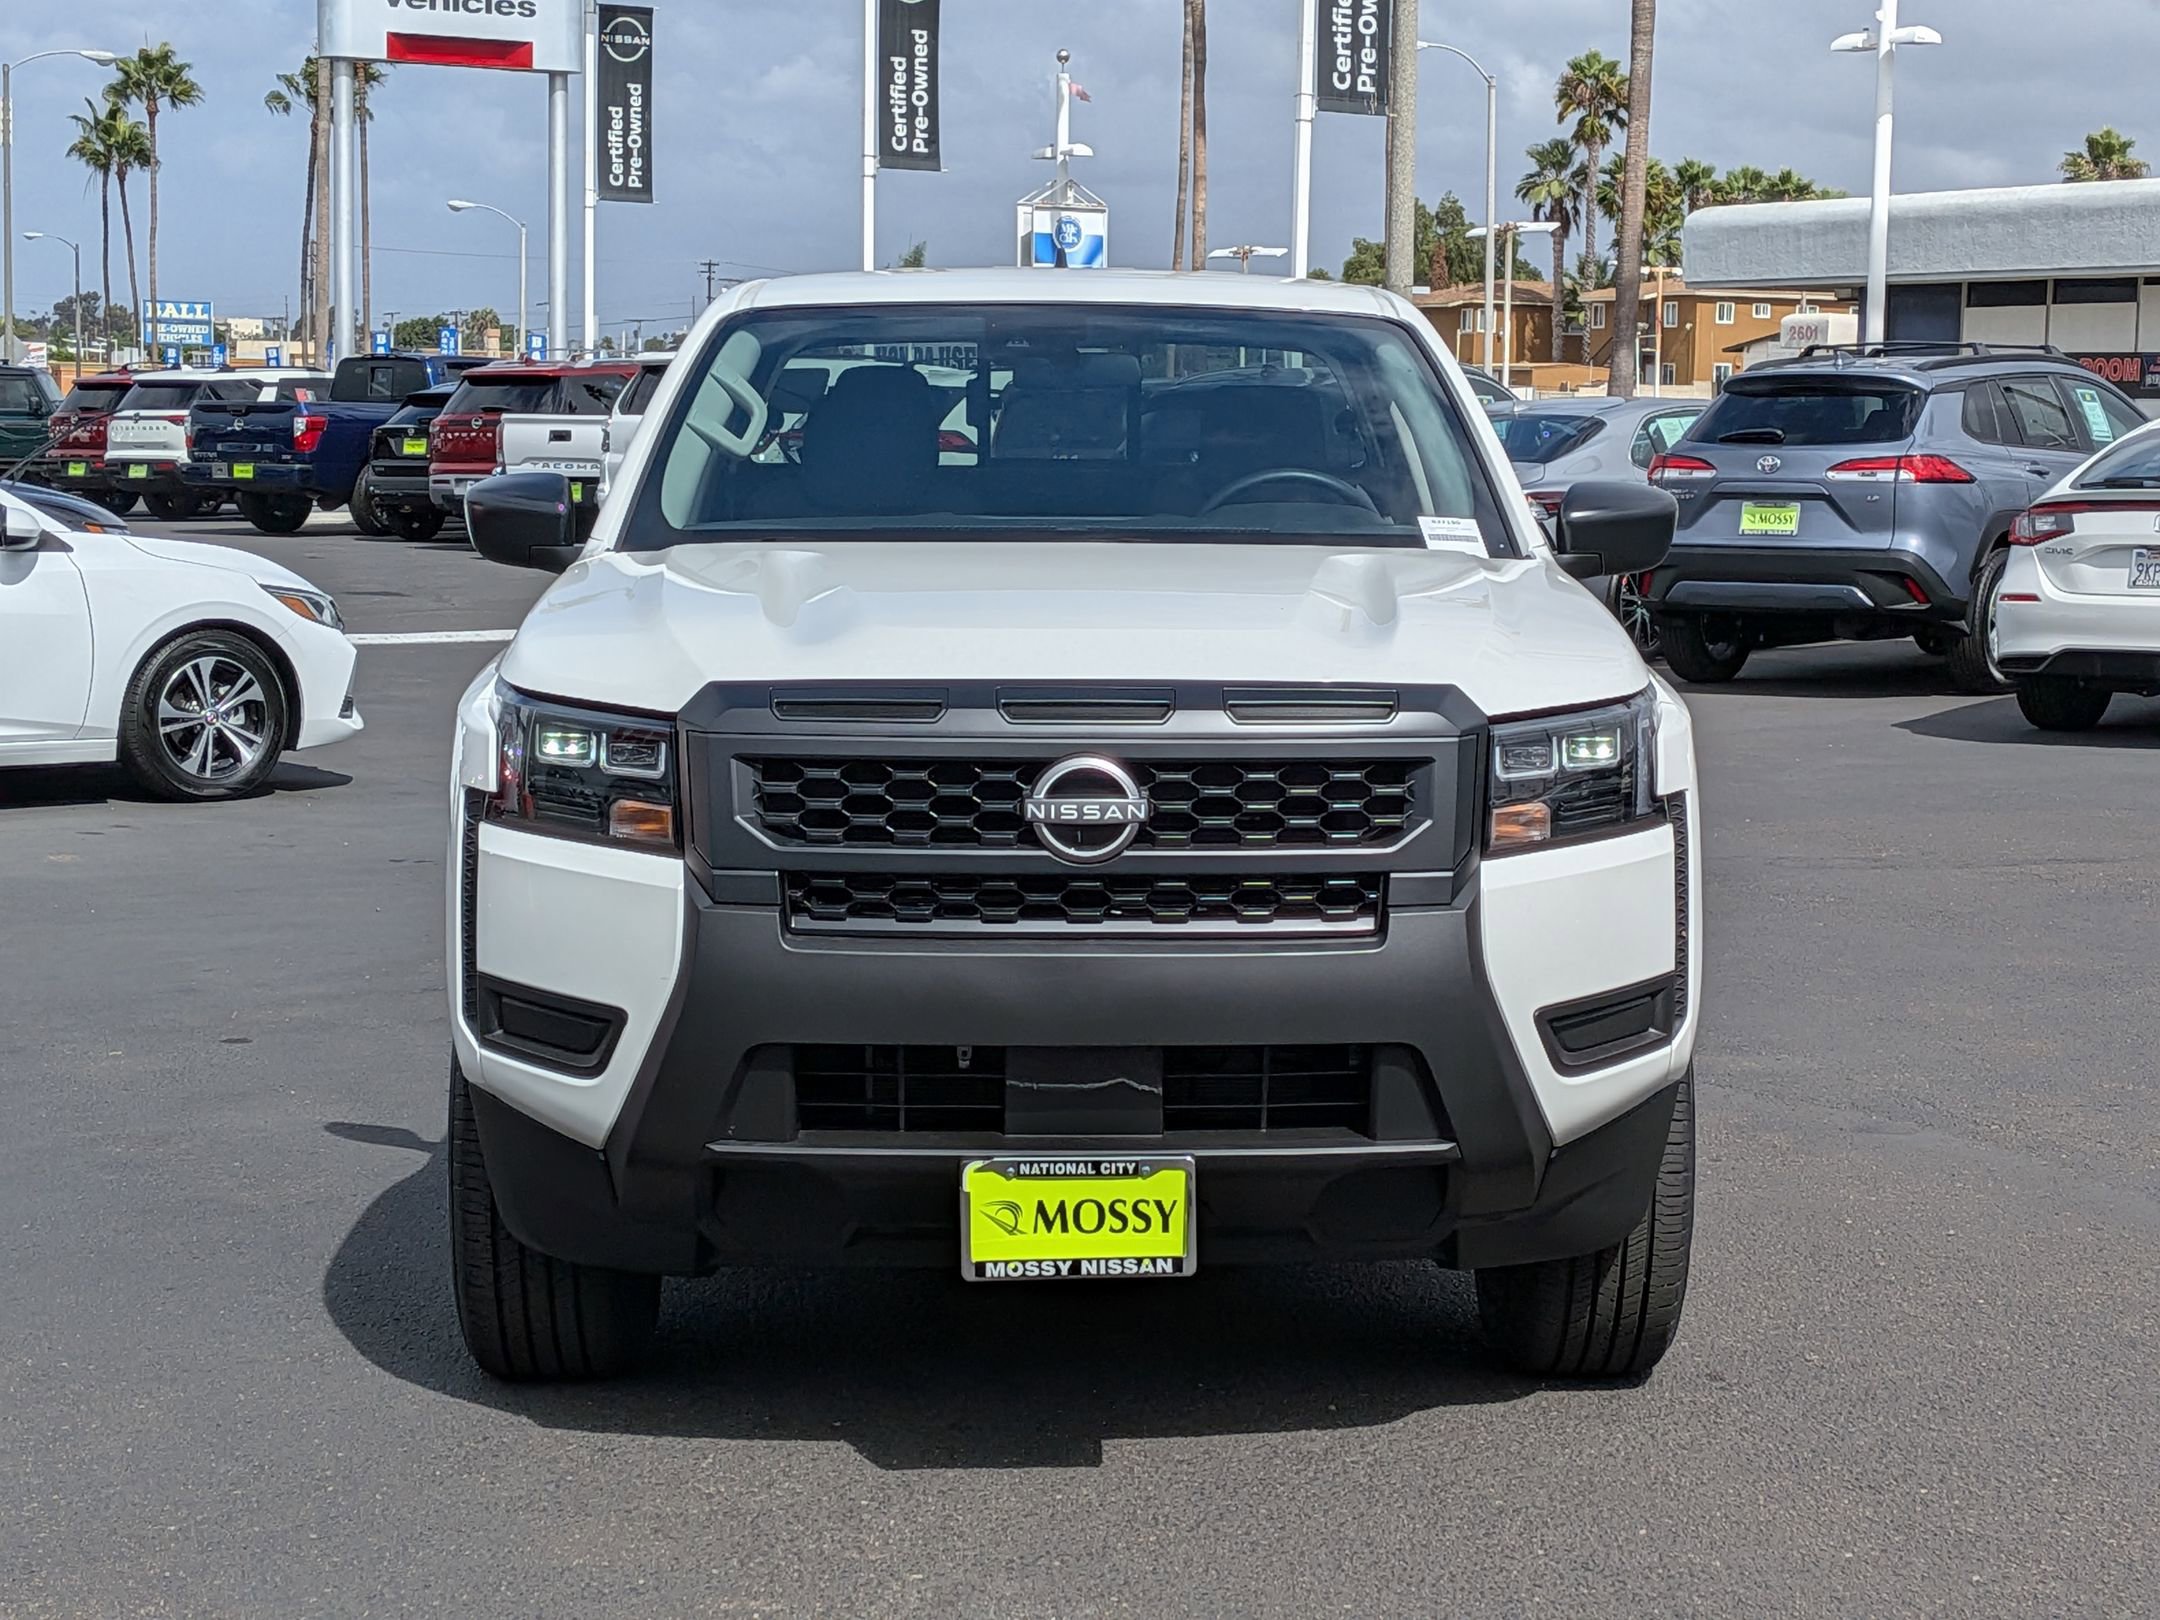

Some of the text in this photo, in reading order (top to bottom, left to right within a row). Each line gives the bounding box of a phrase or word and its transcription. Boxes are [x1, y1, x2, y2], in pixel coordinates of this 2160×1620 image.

[601, 33, 650, 45] NISSAN
[911, 29, 929, 153] Pre-Owned
[890, 56, 907, 151] Certified
[627, 83, 643, 188] Pre-Owned
[608, 106, 624, 187] Certified
[145, 302, 209, 320] BALL
[145, 322, 209, 333] PE-OWNED
[1789, 325, 1818, 340] 2601
[530, 462, 600, 470] TACOMA
[1758, 512, 1795, 525] MOSSY
[2045, 546, 2074, 555] CIVIC
[1027, 803, 1145, 820] NISSAN
[1019, 1162, 1136, 1176] NATIONAL CITY
[1033, 1198, 1178, 1234] MOSSY
[985, 1258, 1174, 1278] MOSSY NISSAN
